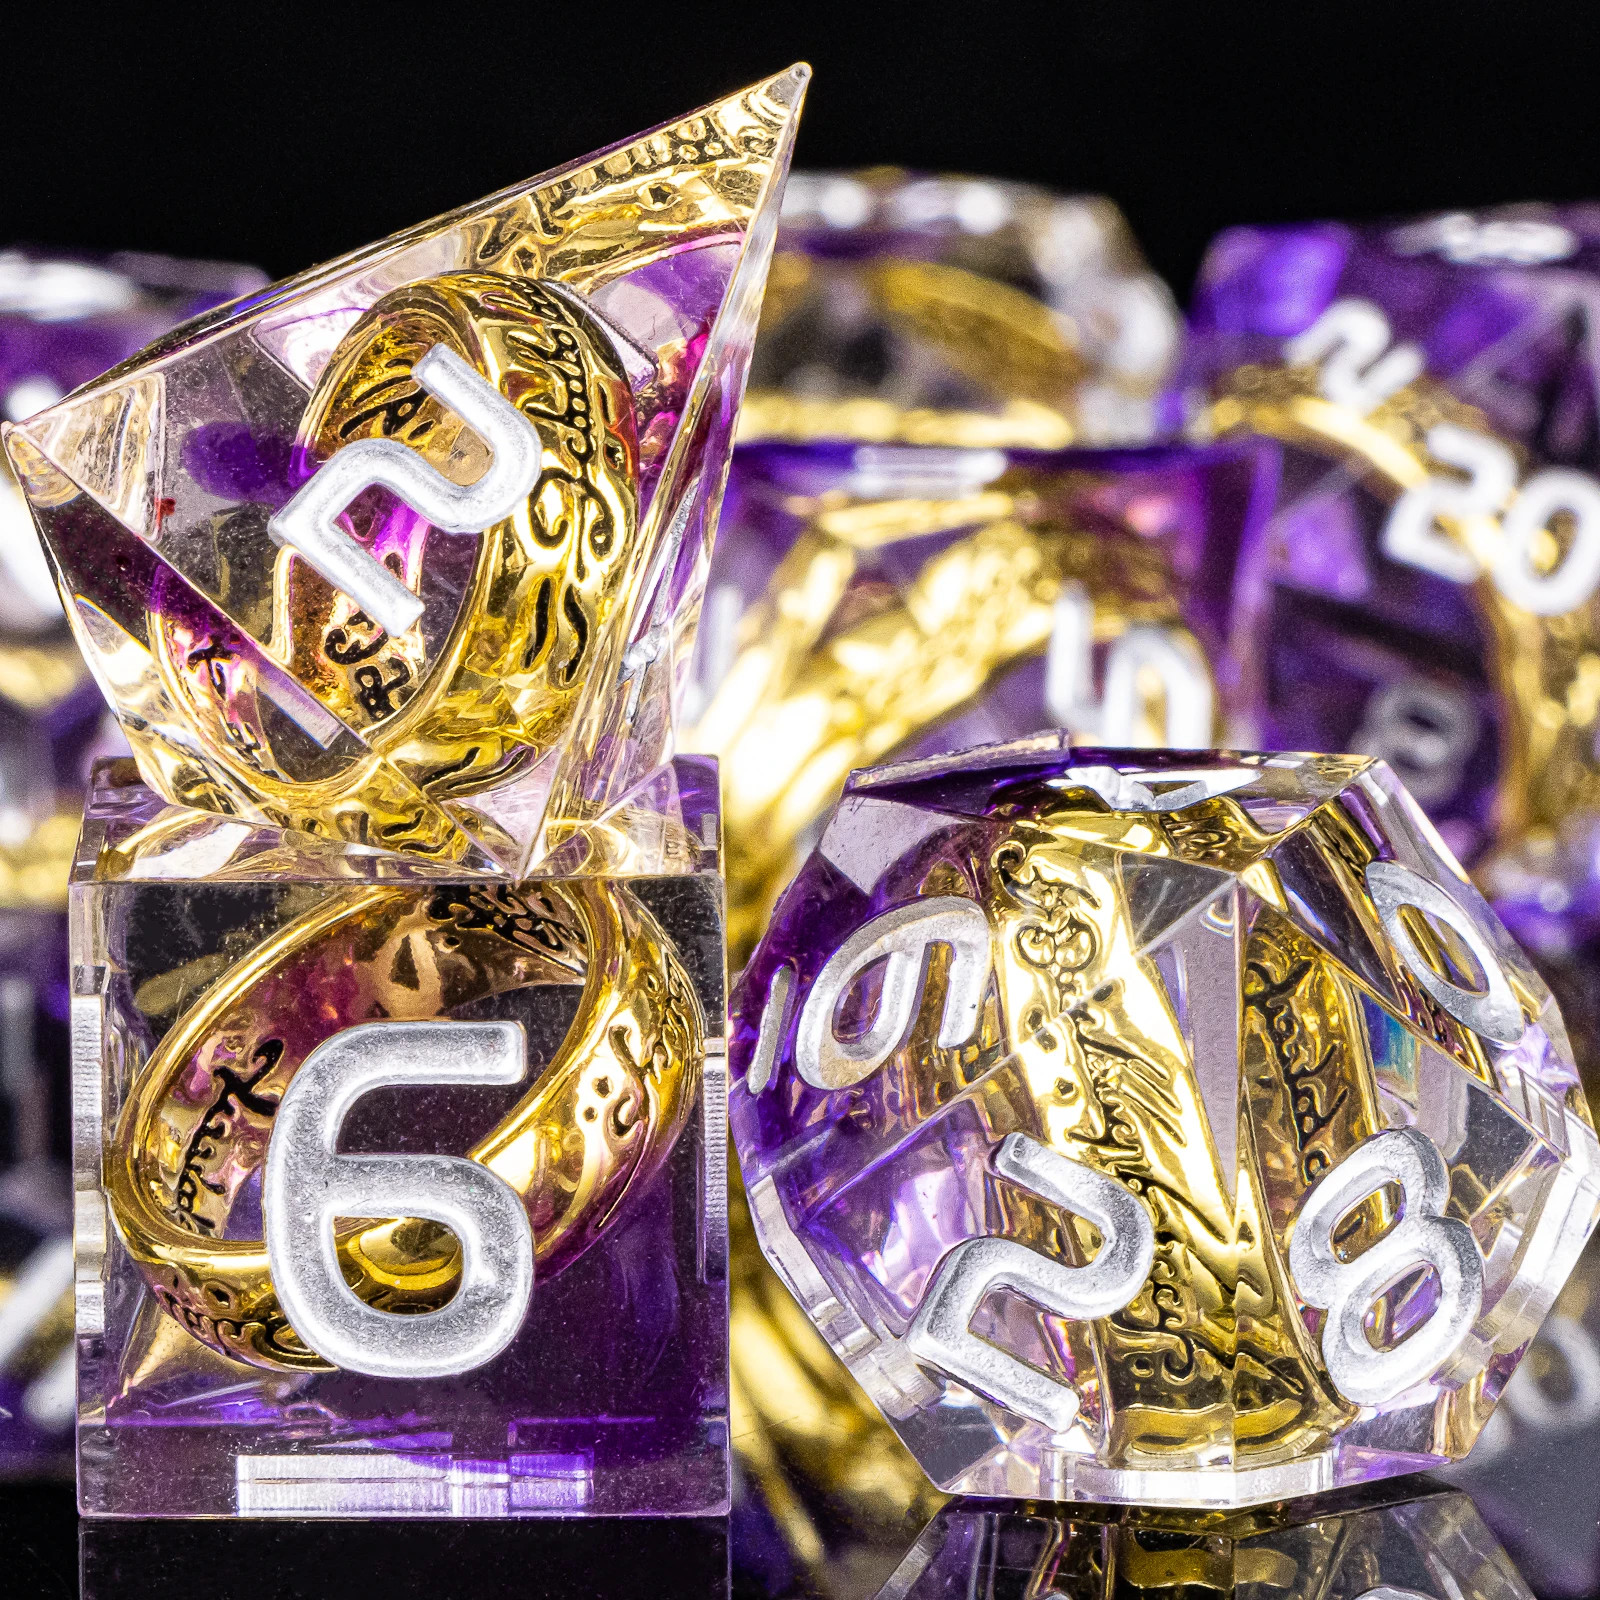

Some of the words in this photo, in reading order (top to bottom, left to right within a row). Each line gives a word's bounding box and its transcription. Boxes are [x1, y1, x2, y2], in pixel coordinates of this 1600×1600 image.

[268, 342, 543, 637] 2
[1280, 298, 1427, 418] 2
[1382, 422, 1600, 617] 20
[1365, 861, 1524, 1043] 0
[264, 1020, 535, 1379] 6
[906, 1131, 1153, 1433] 2
[1288, 1126, 1485, 1407] 8
